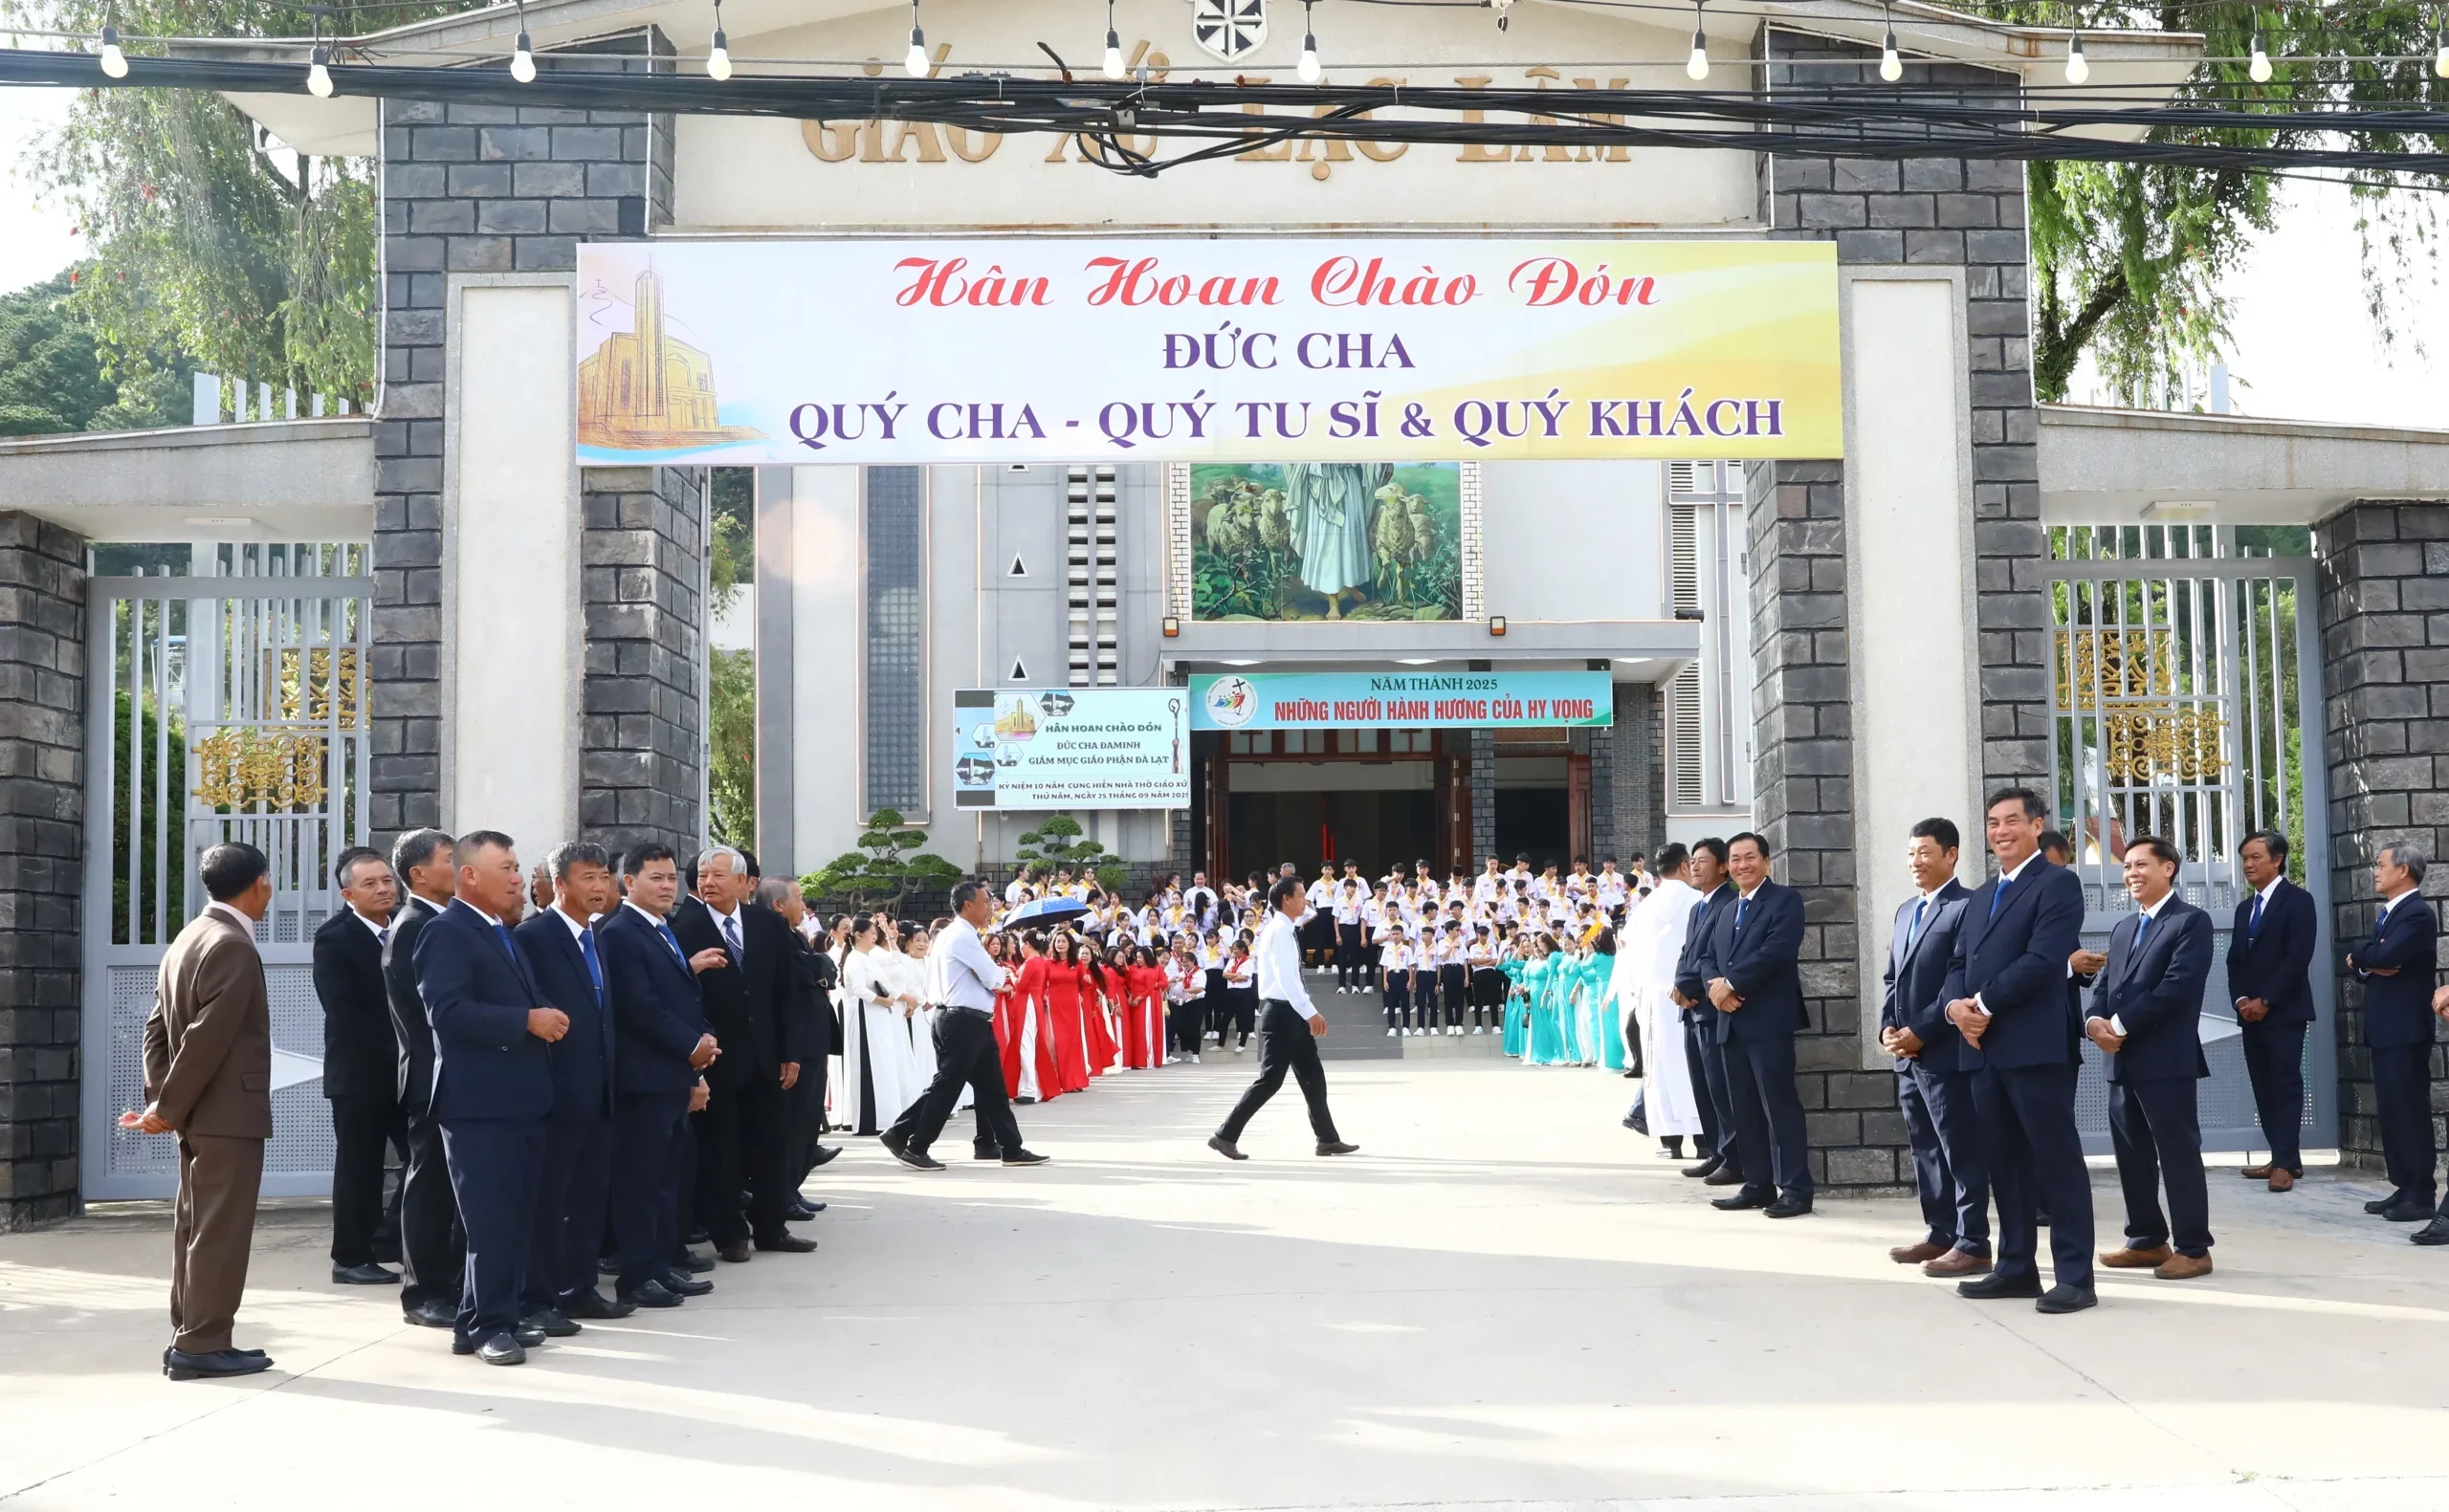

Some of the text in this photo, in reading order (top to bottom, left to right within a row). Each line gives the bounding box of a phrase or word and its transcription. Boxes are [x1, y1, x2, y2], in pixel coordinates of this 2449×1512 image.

[894, 255, 1660, 307] Hân Hoan Chào Đón
[1161, 320, 1415, 369] ĐỨC CHA
[789, 390, 907, 450] QUÝ
[927, 403, 1046, 440] CHA
[1098, 389, 1215, 449] QUÝ
[1236, 402, 1310, 438] TU
[1328, 390, 1381, 438] SĨ
[1401, 402, 1434, 439] &
[1454, 388, 1568, 448] QUÝ
[1588, 389, 1782, 437] KHÁCH
[1371, 675, 1498, 690] NĂM THÁNH 2025
[1275, 697, 1329, 721] NHỮNG
[1334, 699, 1382, 721] NGƯỜI
[1387, 699, 1430, 720] HÀNH
[1435, 699, 1488, 720] HƯƠNG
[1492, 693, 1524, 719] CỦA
[1528, 700, 1547, 718] HY
[1551, 699, 1593, 723] VỌNG
[1046, 721, 1161, 733] HÂN HOAN CHÀO ĐÓN
[1057, 740, 1140, 750] ĐỨC CHA ĐAMINH
[1028, 754, 1169, 766] GIÁM MỤC GIÁO PHẬN ĐÀ LẠT
